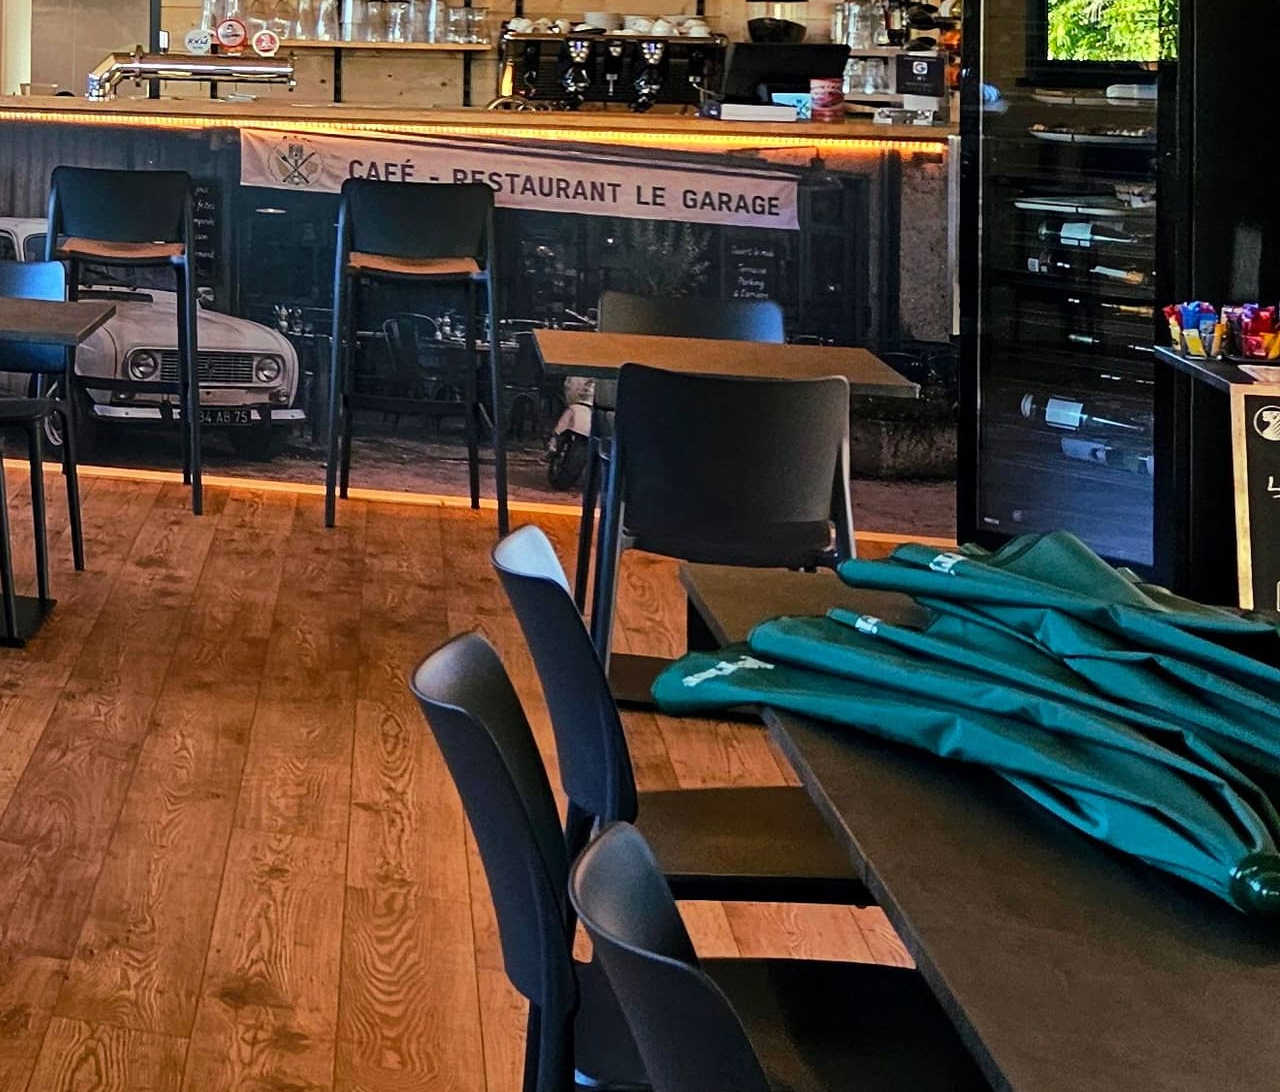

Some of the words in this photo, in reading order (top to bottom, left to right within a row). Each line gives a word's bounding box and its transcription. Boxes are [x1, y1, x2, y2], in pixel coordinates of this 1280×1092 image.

[348, 159, 416, 183] CAFÉ
[453, 168, 622, 204] RESTAURANT
[636, 185, 666, 207] LE
[683, 189, 781, 217] GARAGE
[235, 411, 248, 423] 75
